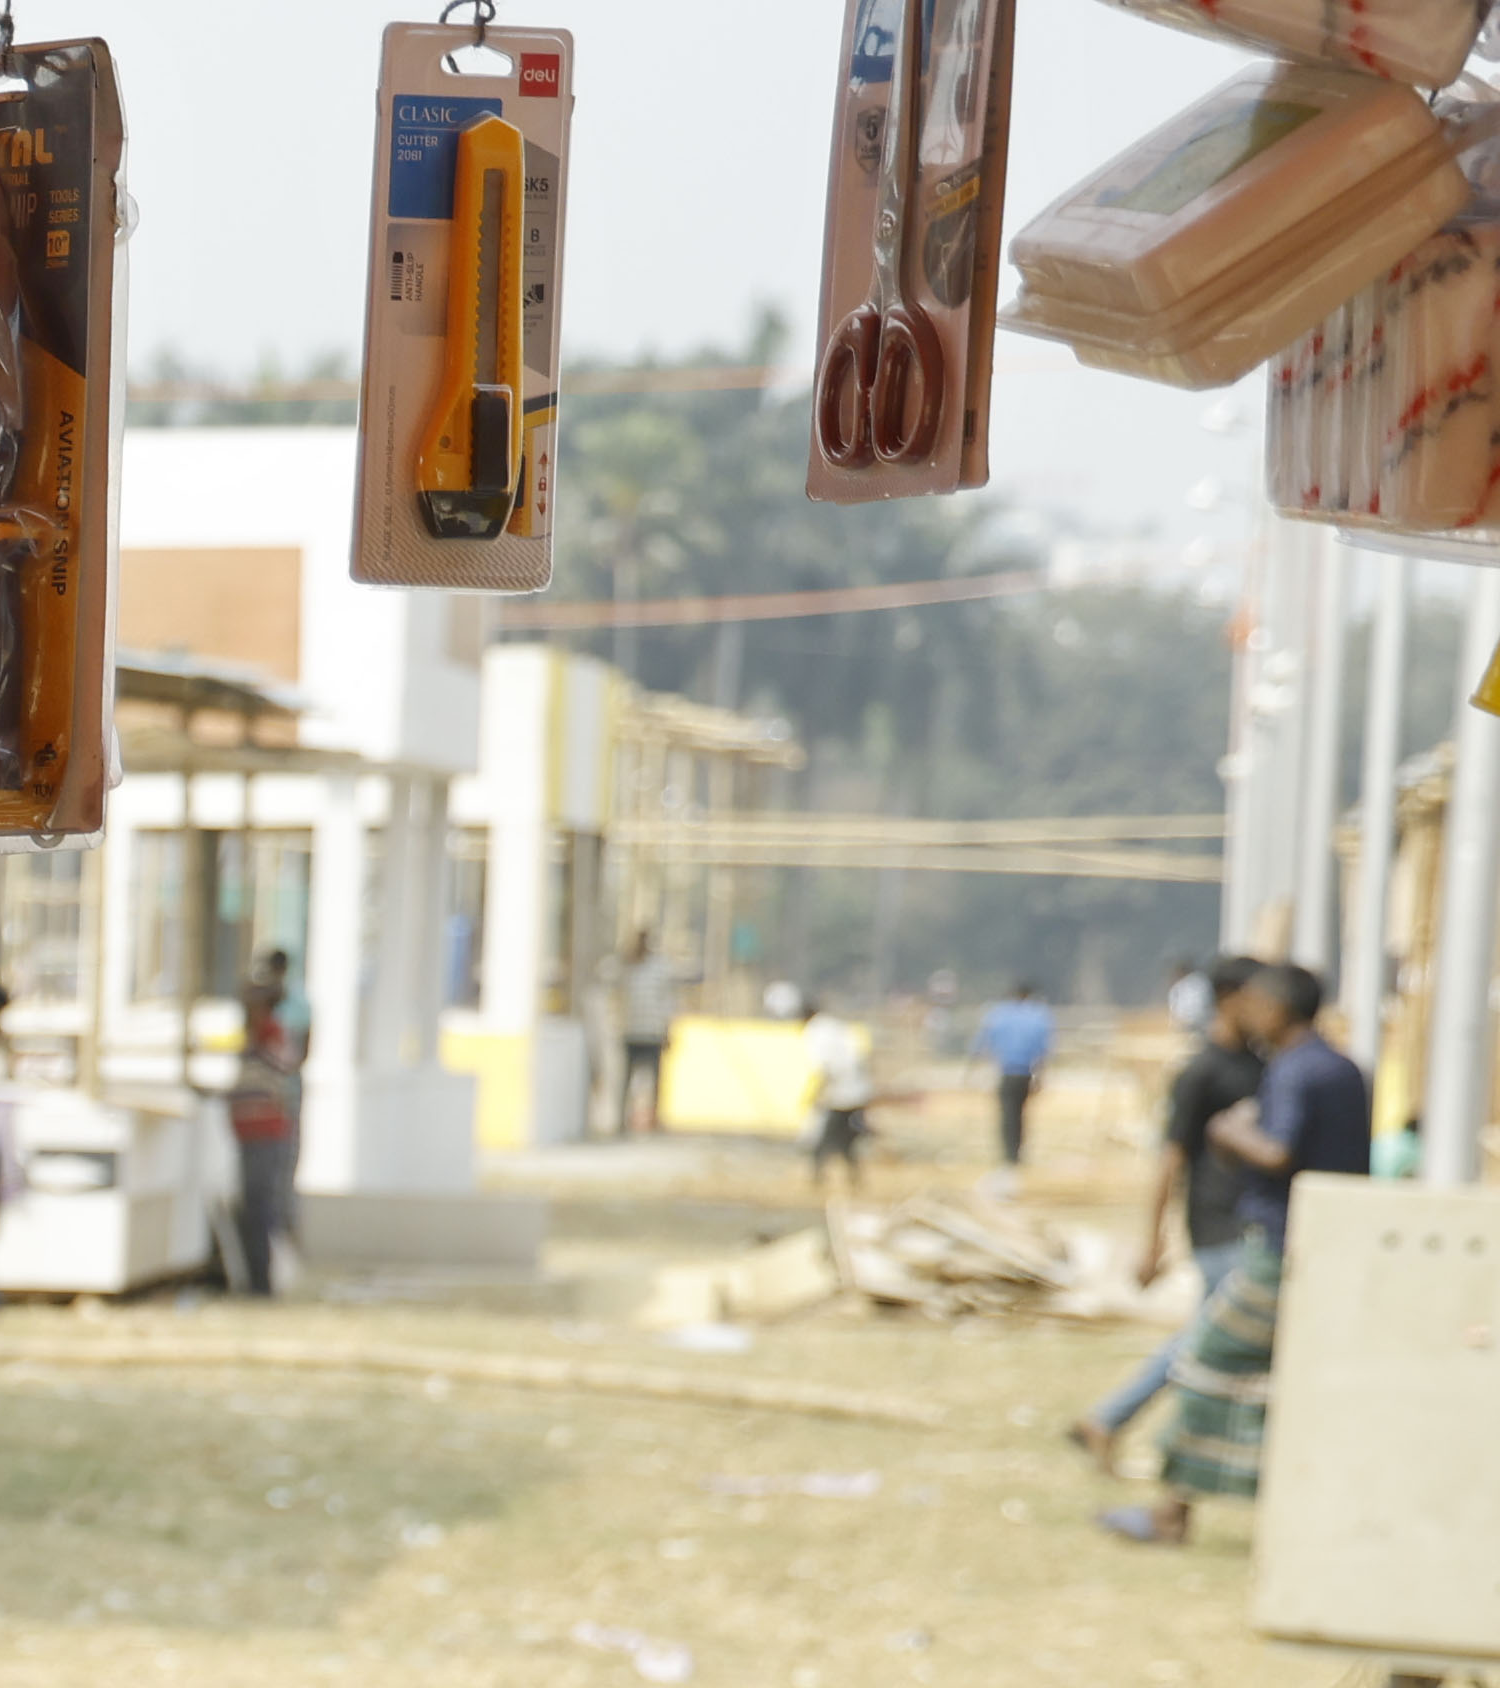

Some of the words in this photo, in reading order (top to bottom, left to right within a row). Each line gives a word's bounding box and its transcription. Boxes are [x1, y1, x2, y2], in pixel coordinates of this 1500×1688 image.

[523, 69, 556, 83] deli
[399, 105, 458, 124] CLASIC
[397, 134, 439, 147] CUTTER
[51, 539, 70, 597] SNIP
